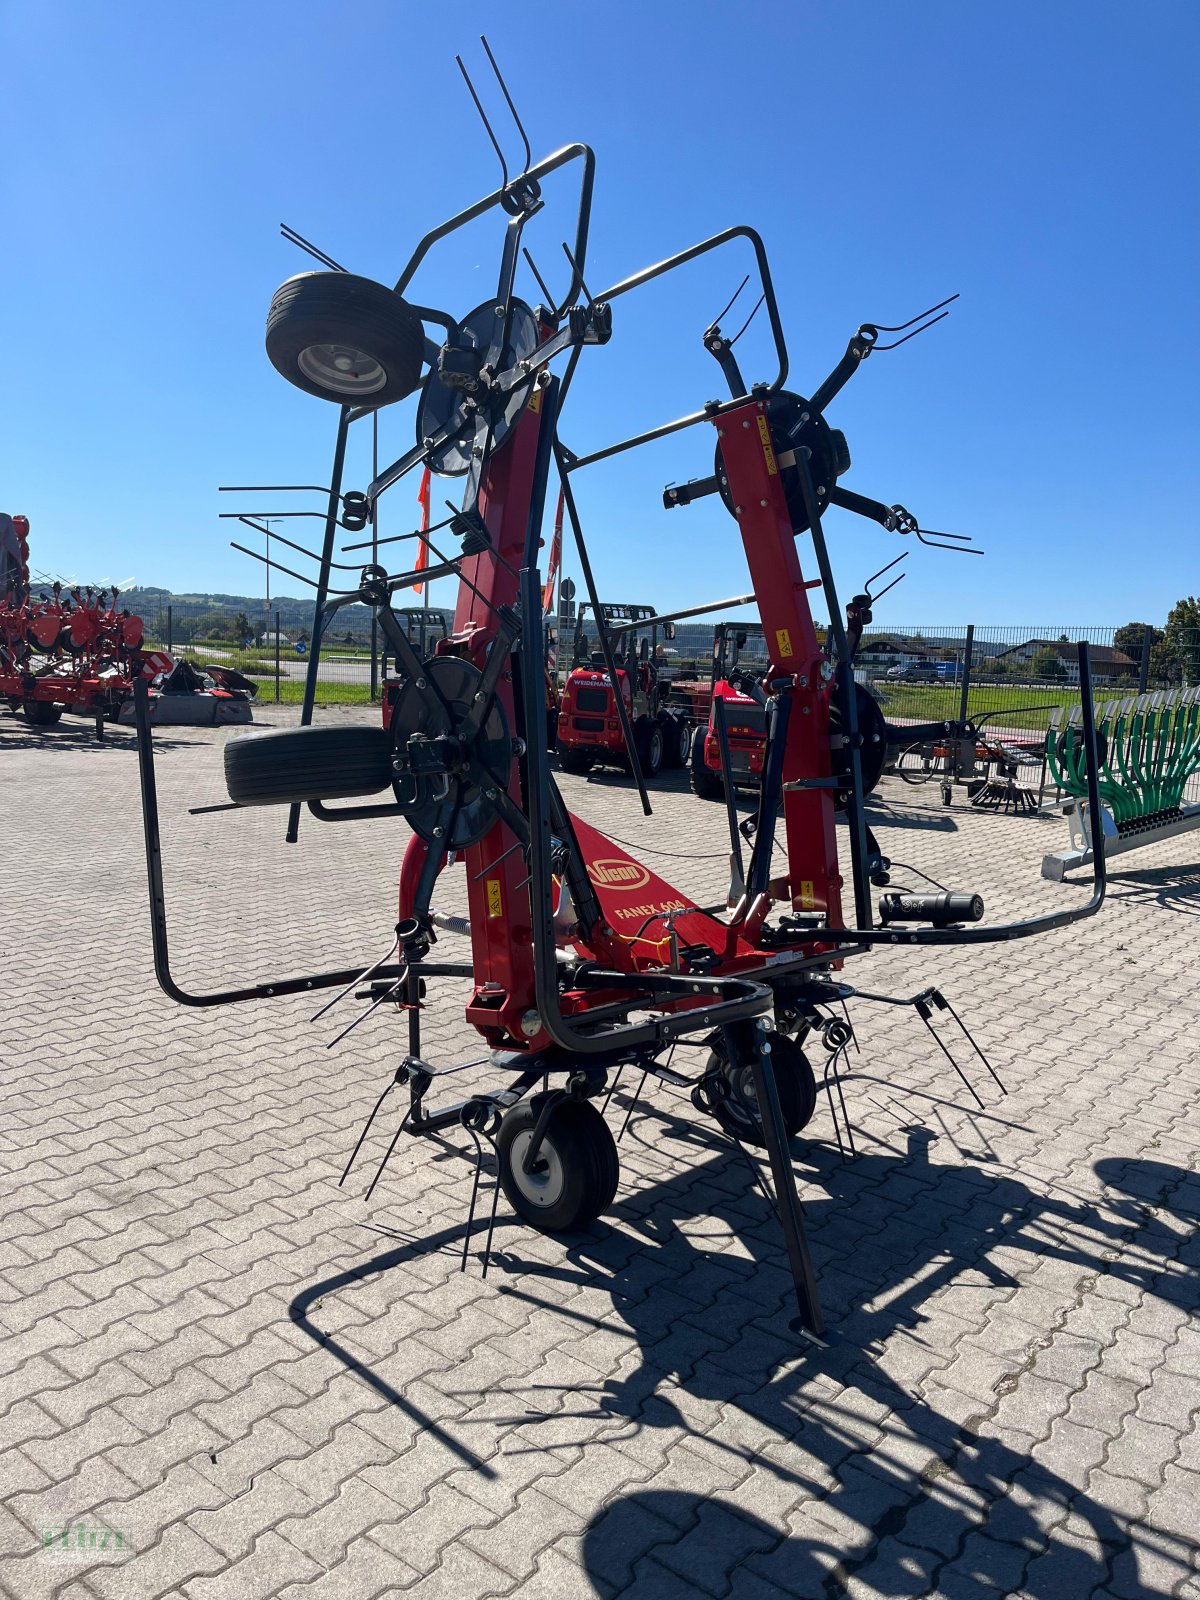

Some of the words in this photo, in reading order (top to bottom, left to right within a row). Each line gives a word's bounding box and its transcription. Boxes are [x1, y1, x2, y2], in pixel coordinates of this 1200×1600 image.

[586, 860, 641, 883] Vicon
[614, 904, 660, 919] FANEX
[660, 900, 686, 913] 604
